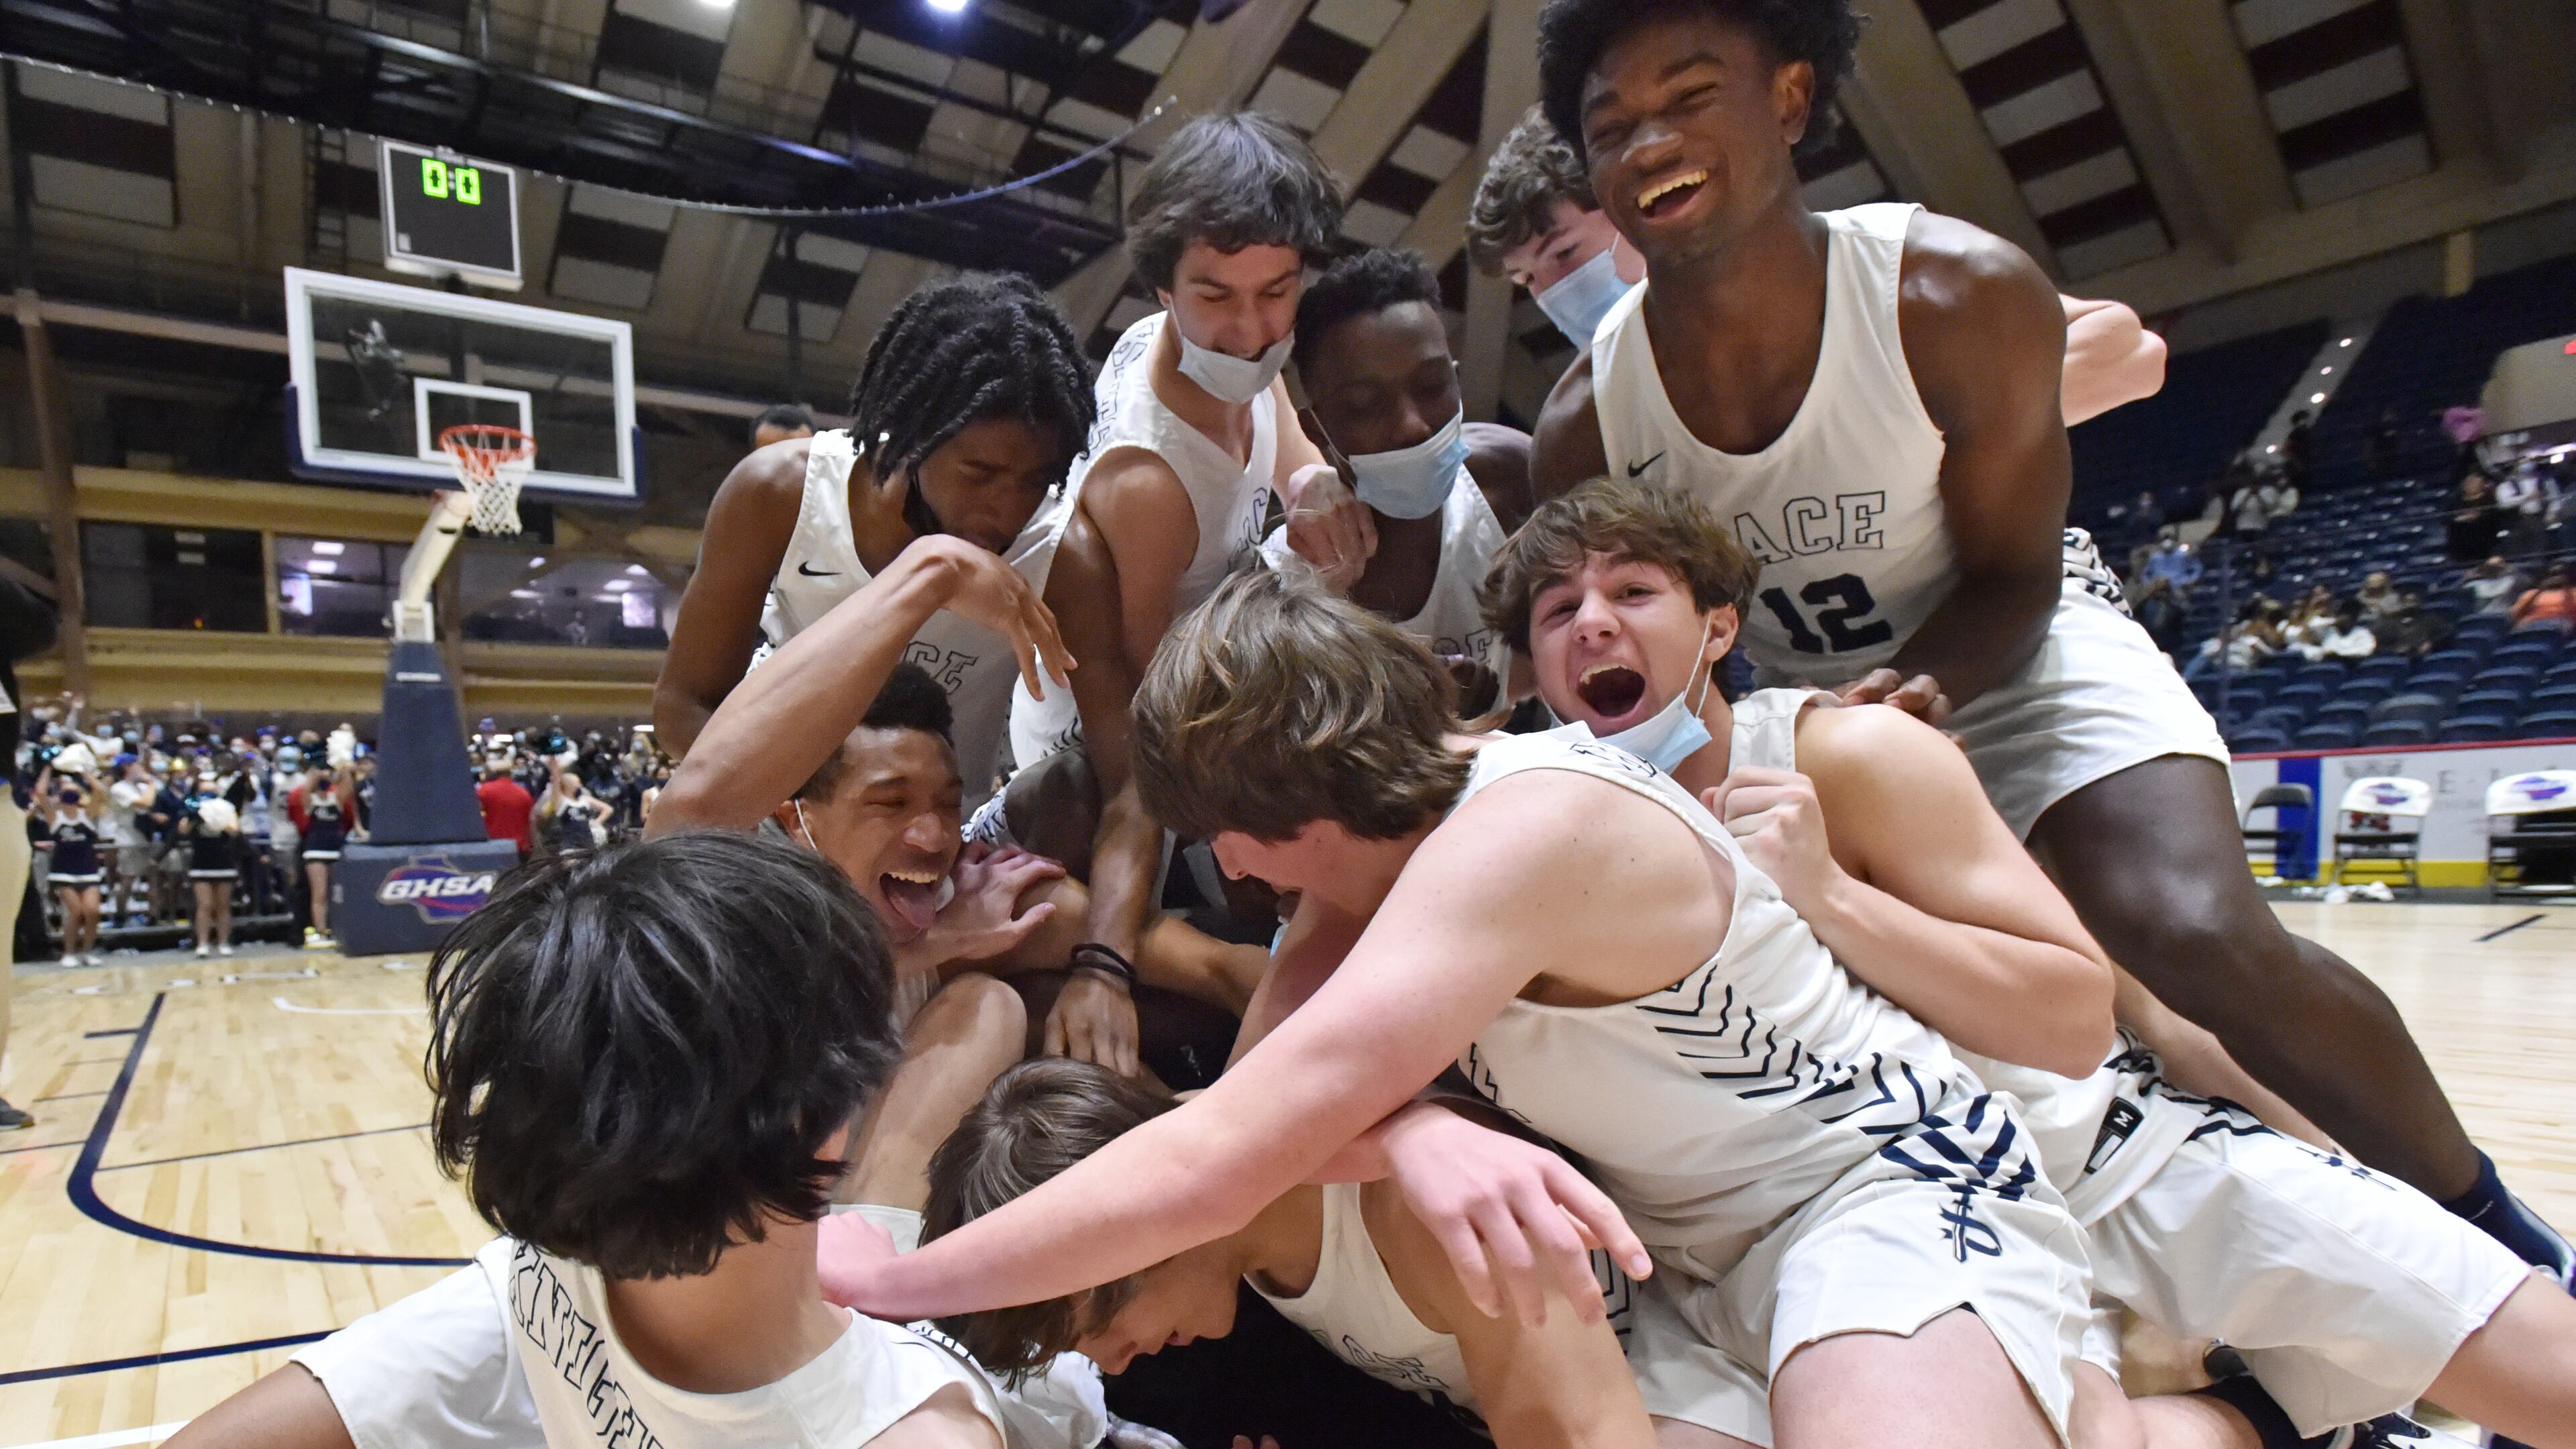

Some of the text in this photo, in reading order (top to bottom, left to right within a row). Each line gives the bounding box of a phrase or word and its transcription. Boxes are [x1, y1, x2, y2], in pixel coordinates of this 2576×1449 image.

[1759, 573, 1893, 654] 12
[380, 874, 495, 900] GHSA
[2113, 1110, 2134, 1128] M
